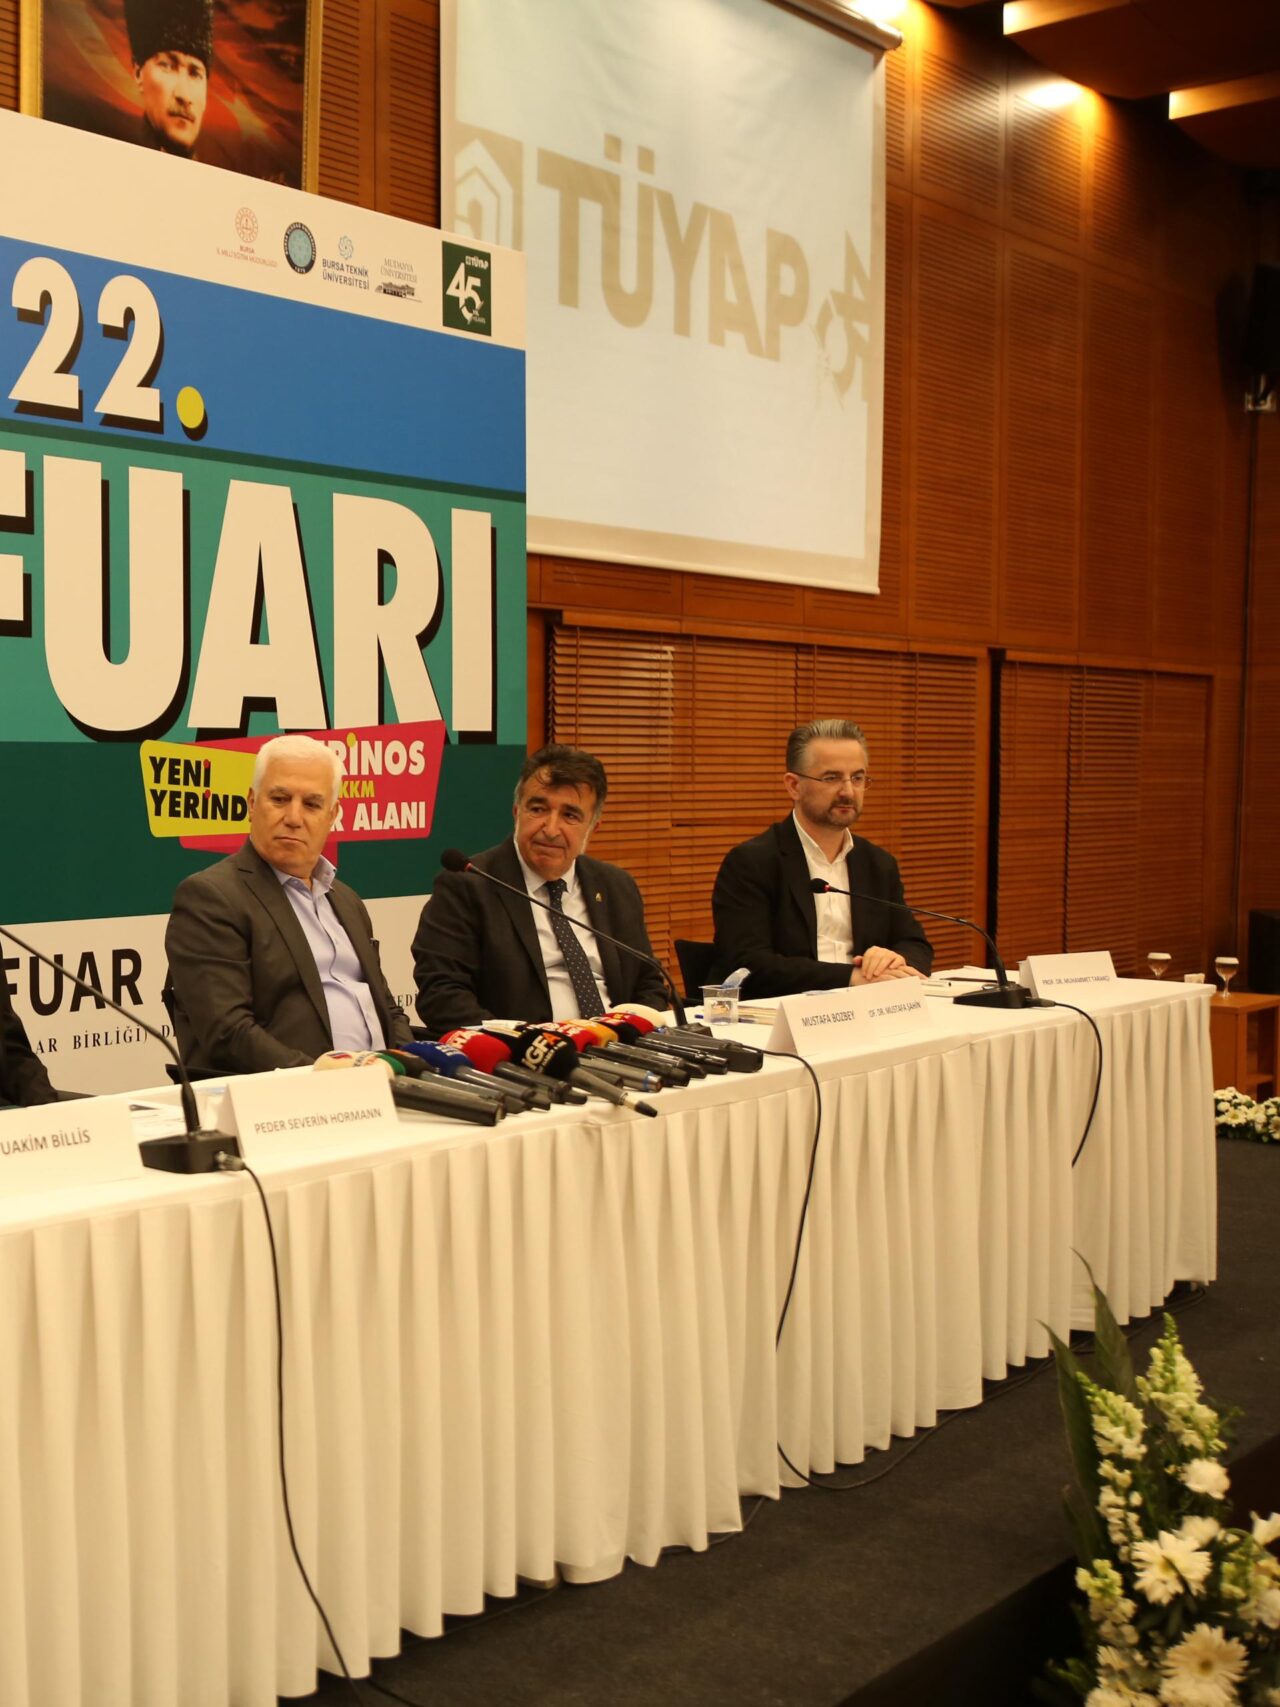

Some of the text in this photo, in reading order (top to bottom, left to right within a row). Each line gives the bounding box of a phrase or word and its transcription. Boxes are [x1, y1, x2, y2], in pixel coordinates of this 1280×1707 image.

[537, 133, 811, 363] TÜYAP
[322, 258, 369, 278] BURSA TEKNİK
[322, 269, 370, 290] ÜNİVERSİTESİ
[8, 256, 206, 429] 22.
[321, 731, 426, 776] RİNOS
[148, 756, 212, 788] YENİ
[338, 780, 375, 799] KKM
[149, 789, 250, 822] YERİND
[352, 801, 426, 832] ALANI
[801, 1010, 855, 1027] MUSTAFA BOZBEY
[254, 1108, 382, 1134] PEDER SEVERİN HORMANN
[50, 1127, 91, 1148] BİLLİS
